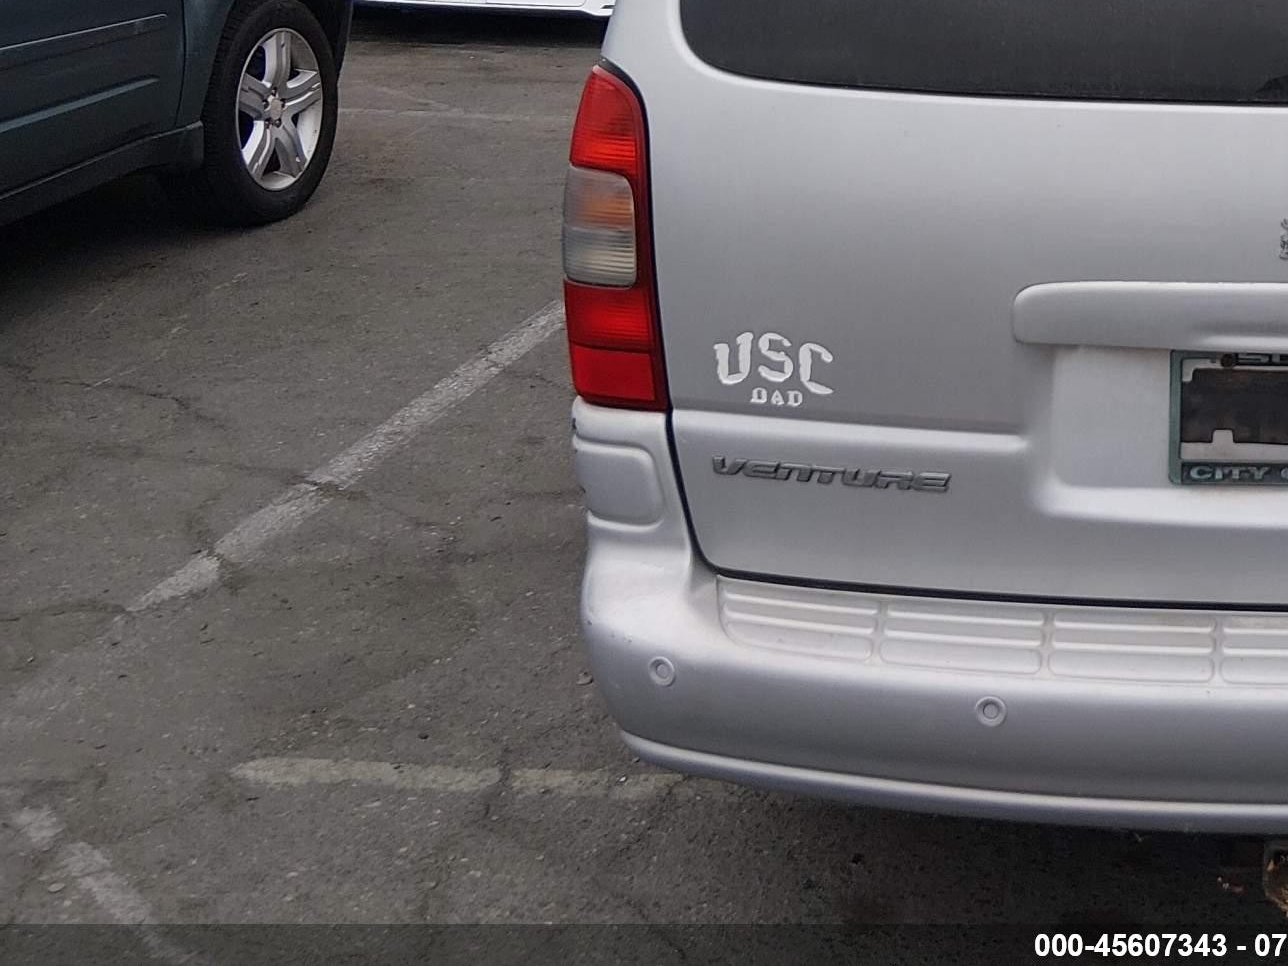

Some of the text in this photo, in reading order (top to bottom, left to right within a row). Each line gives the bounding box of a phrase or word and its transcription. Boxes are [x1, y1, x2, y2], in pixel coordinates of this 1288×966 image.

[713, 331, 834, 395] USC
[750, 387, 804, 407] DAD
[712, 454, 952, 493] VENTURE
[1189, 465, 1270, 480] CITY
